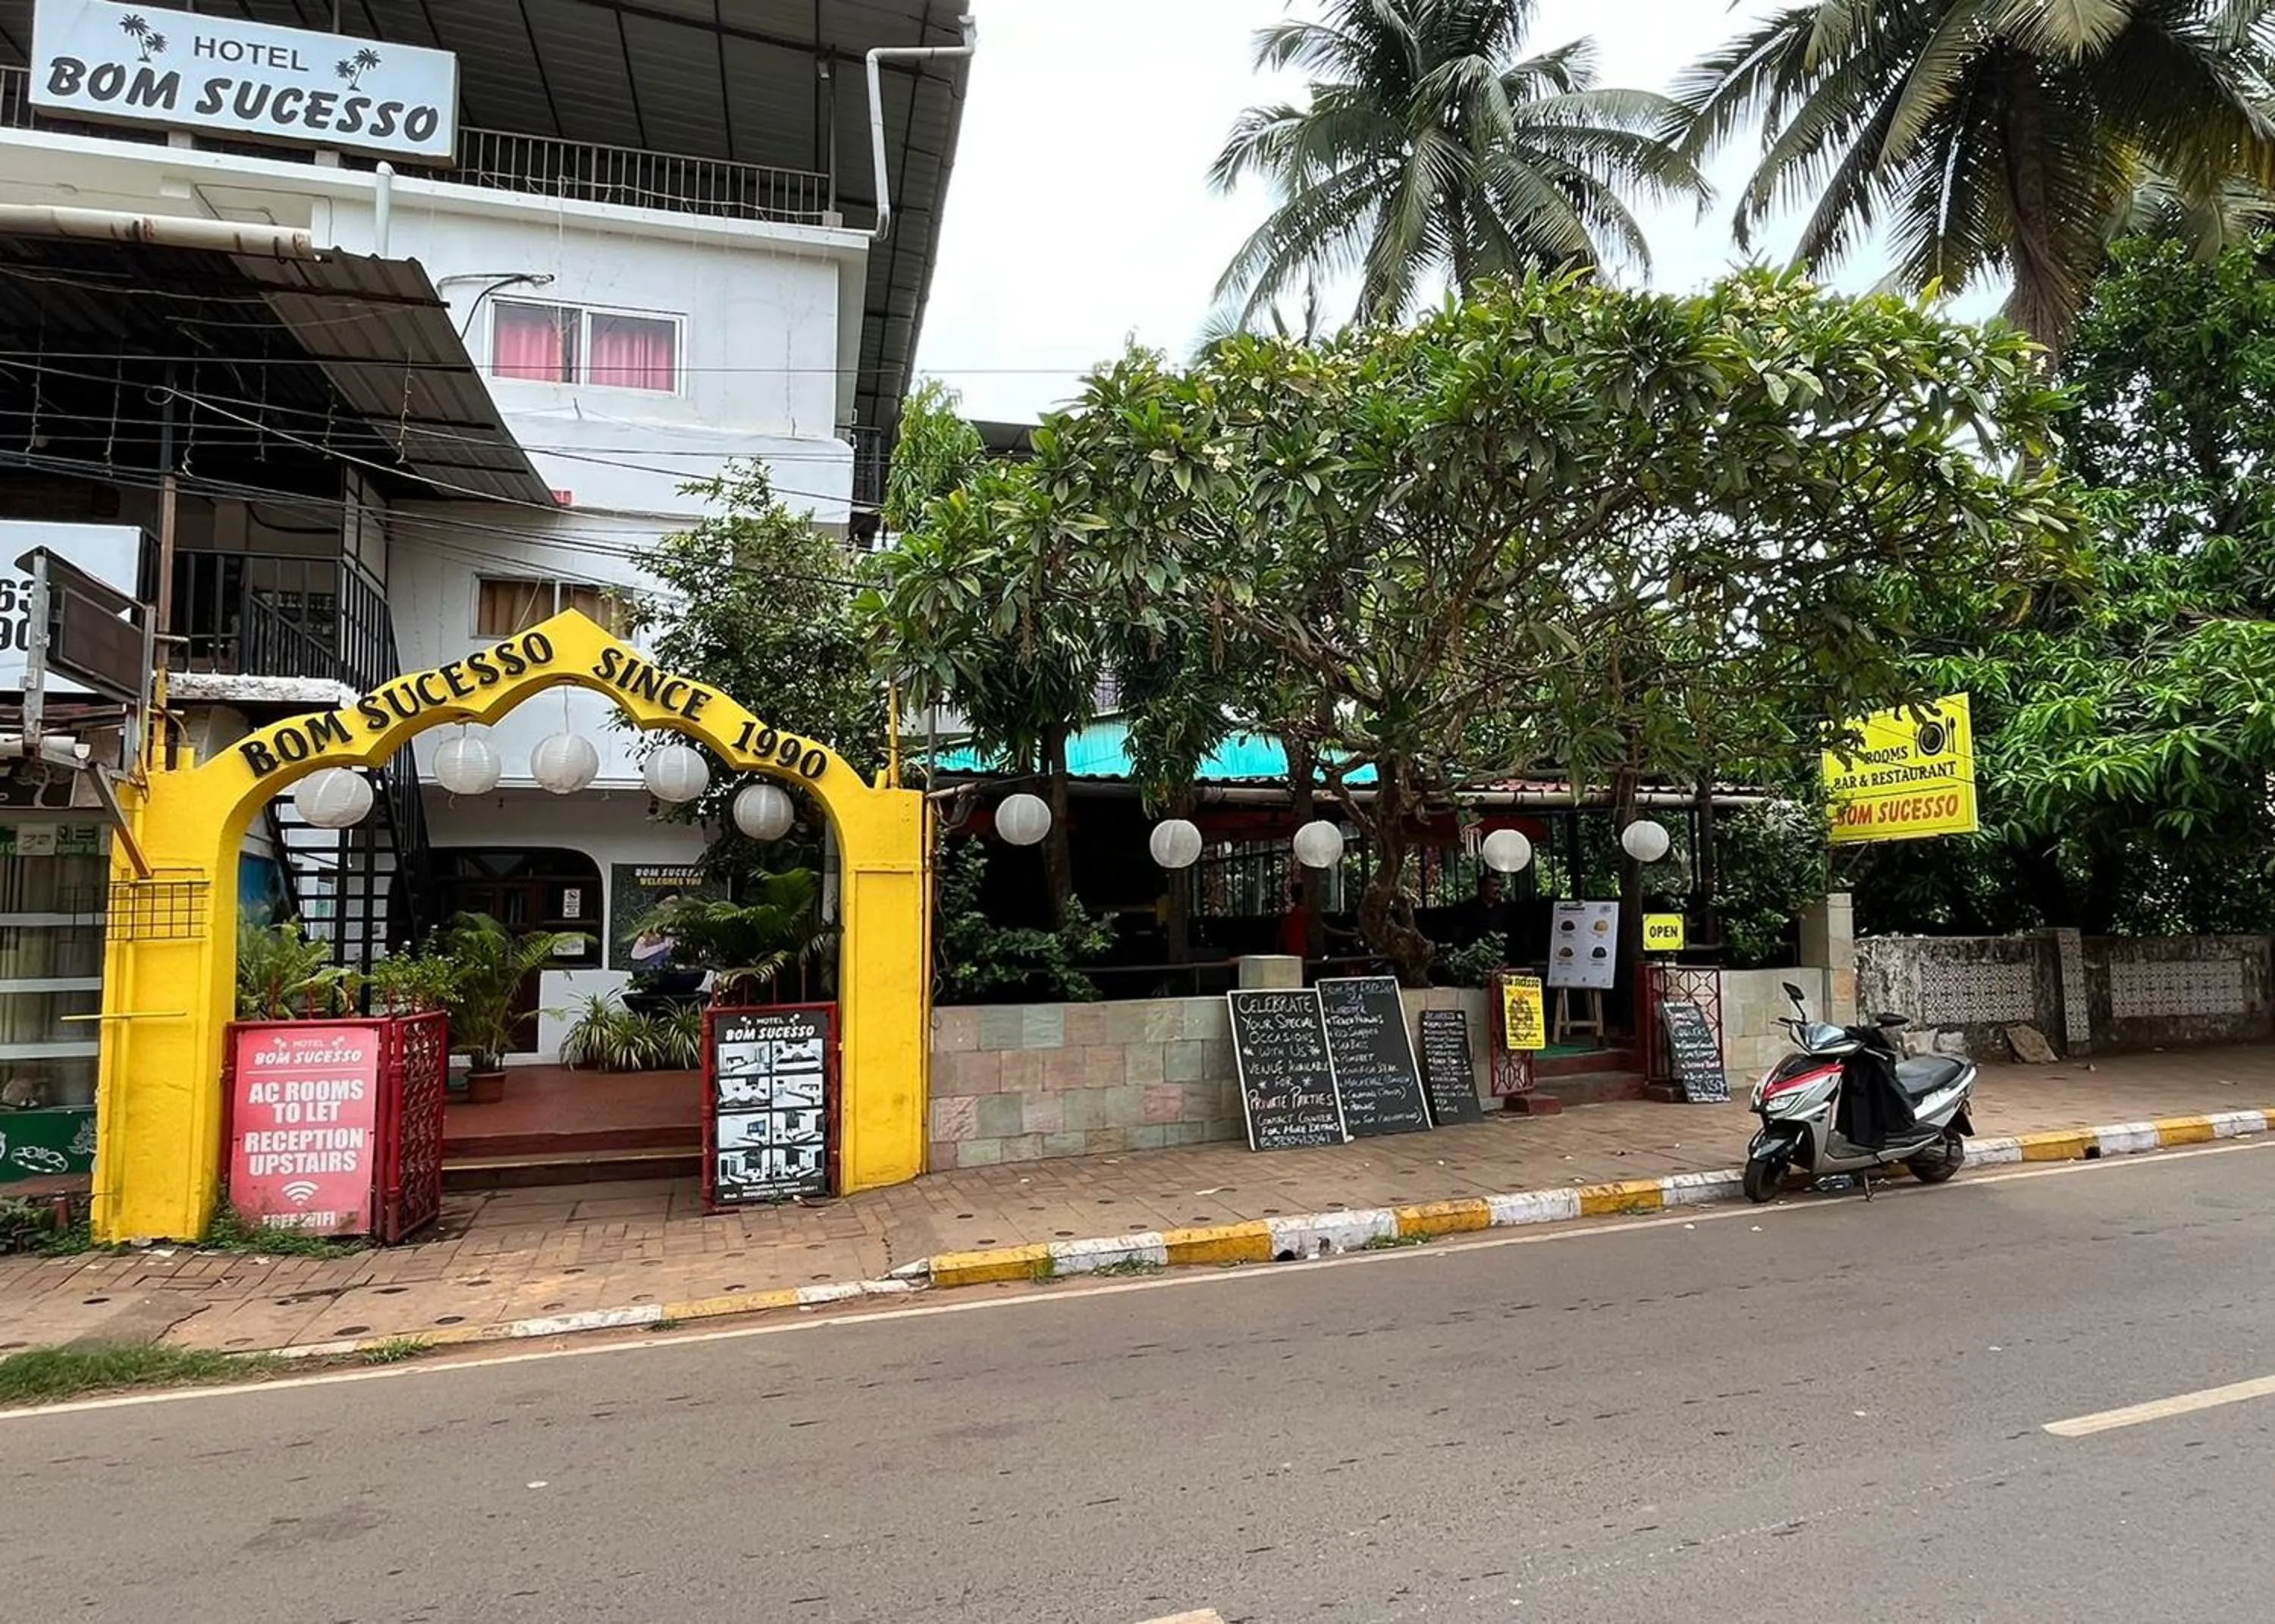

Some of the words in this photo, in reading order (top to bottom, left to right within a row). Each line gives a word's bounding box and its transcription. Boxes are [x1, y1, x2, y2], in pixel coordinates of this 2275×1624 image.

[194, 36, 309, 72] HOTEL
[46, 56, 182, 111] BOM
[194, 77, 439, 143] SUCESSO
[238, 710, 353, 779] BOM
[358, 632, 554, 731] SUCESSO
[592, 647, 713, 723] SINCE
[733, 720, 828, 780] 1990
[1866, 745, 1909, 764] ROOMS
[1834, 776, 1858, 791] BAR
[1859, 773, 1868, 788] &
[1871, 760, 1956, 786] RESTAURANT
[1877, 794, 1959, 824] SUCESSO
[1649, 925, 1678, 939] OPEN
[1237, 994, 1313, 1014] CELEBRATE
[757, 1017, 784, 1025] HOTEL
[1241, 1016, 1274, 1030] YOUR
[1274, 1014, 1317, 1029] SPECIAL
[726, 1028, 756, 1042] BOM
[758, 1024, 815, 1040] SUCESSO
[1249, 1030, 1316, 1044] OCCASIONS
[292, 1039, 325, 1047] HOTEL
[1258, 1046, 1285, 1058] WITH
[1290, 1044, 1307, 1058] US
[254, 1051, 290, 1065] BOM
[293, 1049, 362, 1064] SUCESSO
[1246, 1060, 1283, 1074] VENUE
[1275, 1075, 1294, 1087] FOR
[249, 1082, 279, 1104] AC
[285, 1079, 364, 1102] ROOMS
[1247, 1088, 1288, 1111] PRIVATE
[1289, 1085, 1335, 1109] PARTIES
[271, 1102, 300, 1124] TO
[306, 1100, 341, 1122] LET
[245, 1127, 364, 1153] RECEPTION
[249, 1150, 357, 1176] UPSTAIRS
